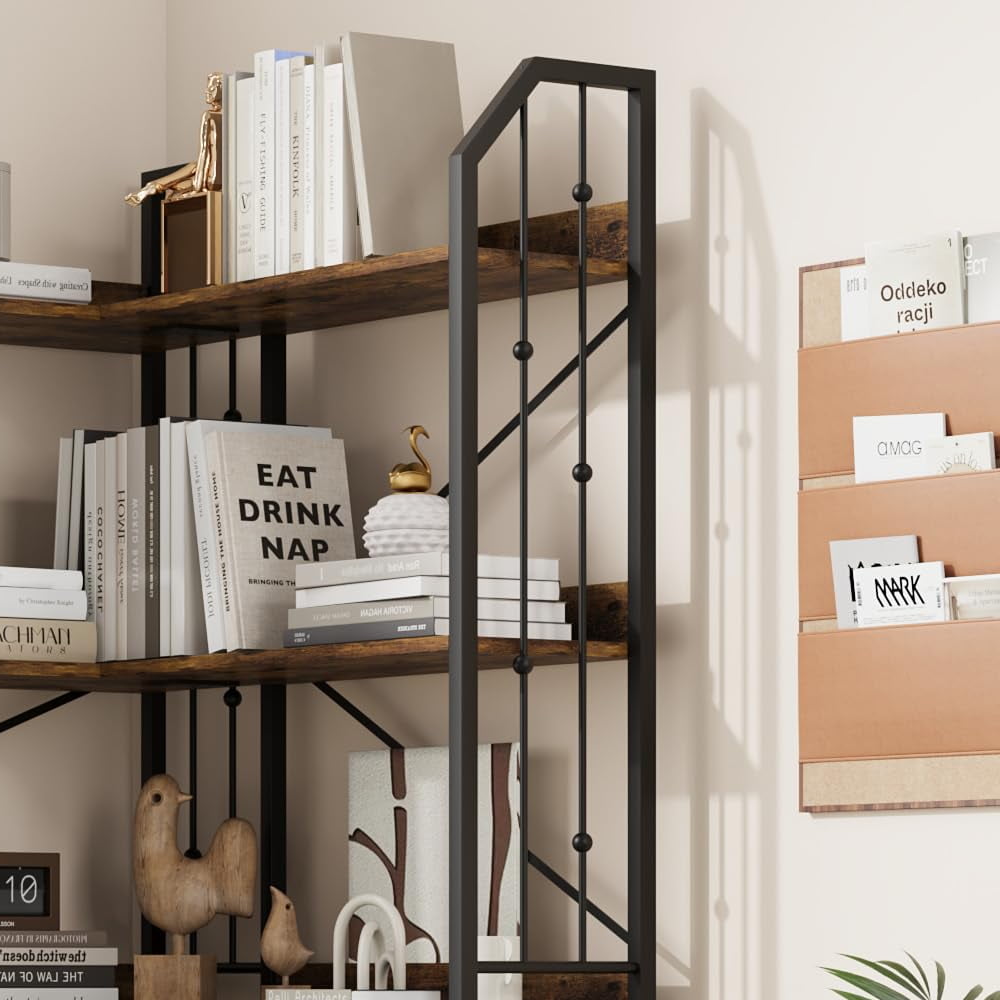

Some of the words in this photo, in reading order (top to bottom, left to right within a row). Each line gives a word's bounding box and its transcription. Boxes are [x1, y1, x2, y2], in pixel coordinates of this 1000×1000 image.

[292, 136, 300, 198] KINFOLK
[880, 280, 946, 302] Oddeko
[897, 302, 934, 324] racji
[212, 472, 220, 500] HOME
[257, 463, 317, 490] EAT
[238, 498, 344, 528] DRINK
[260, 536, 329, 562] NAP
[248, 578, 282, 586] BRINGING
[874, 574, 926, 608] MARK
[6, 874, 38, 904] 10
